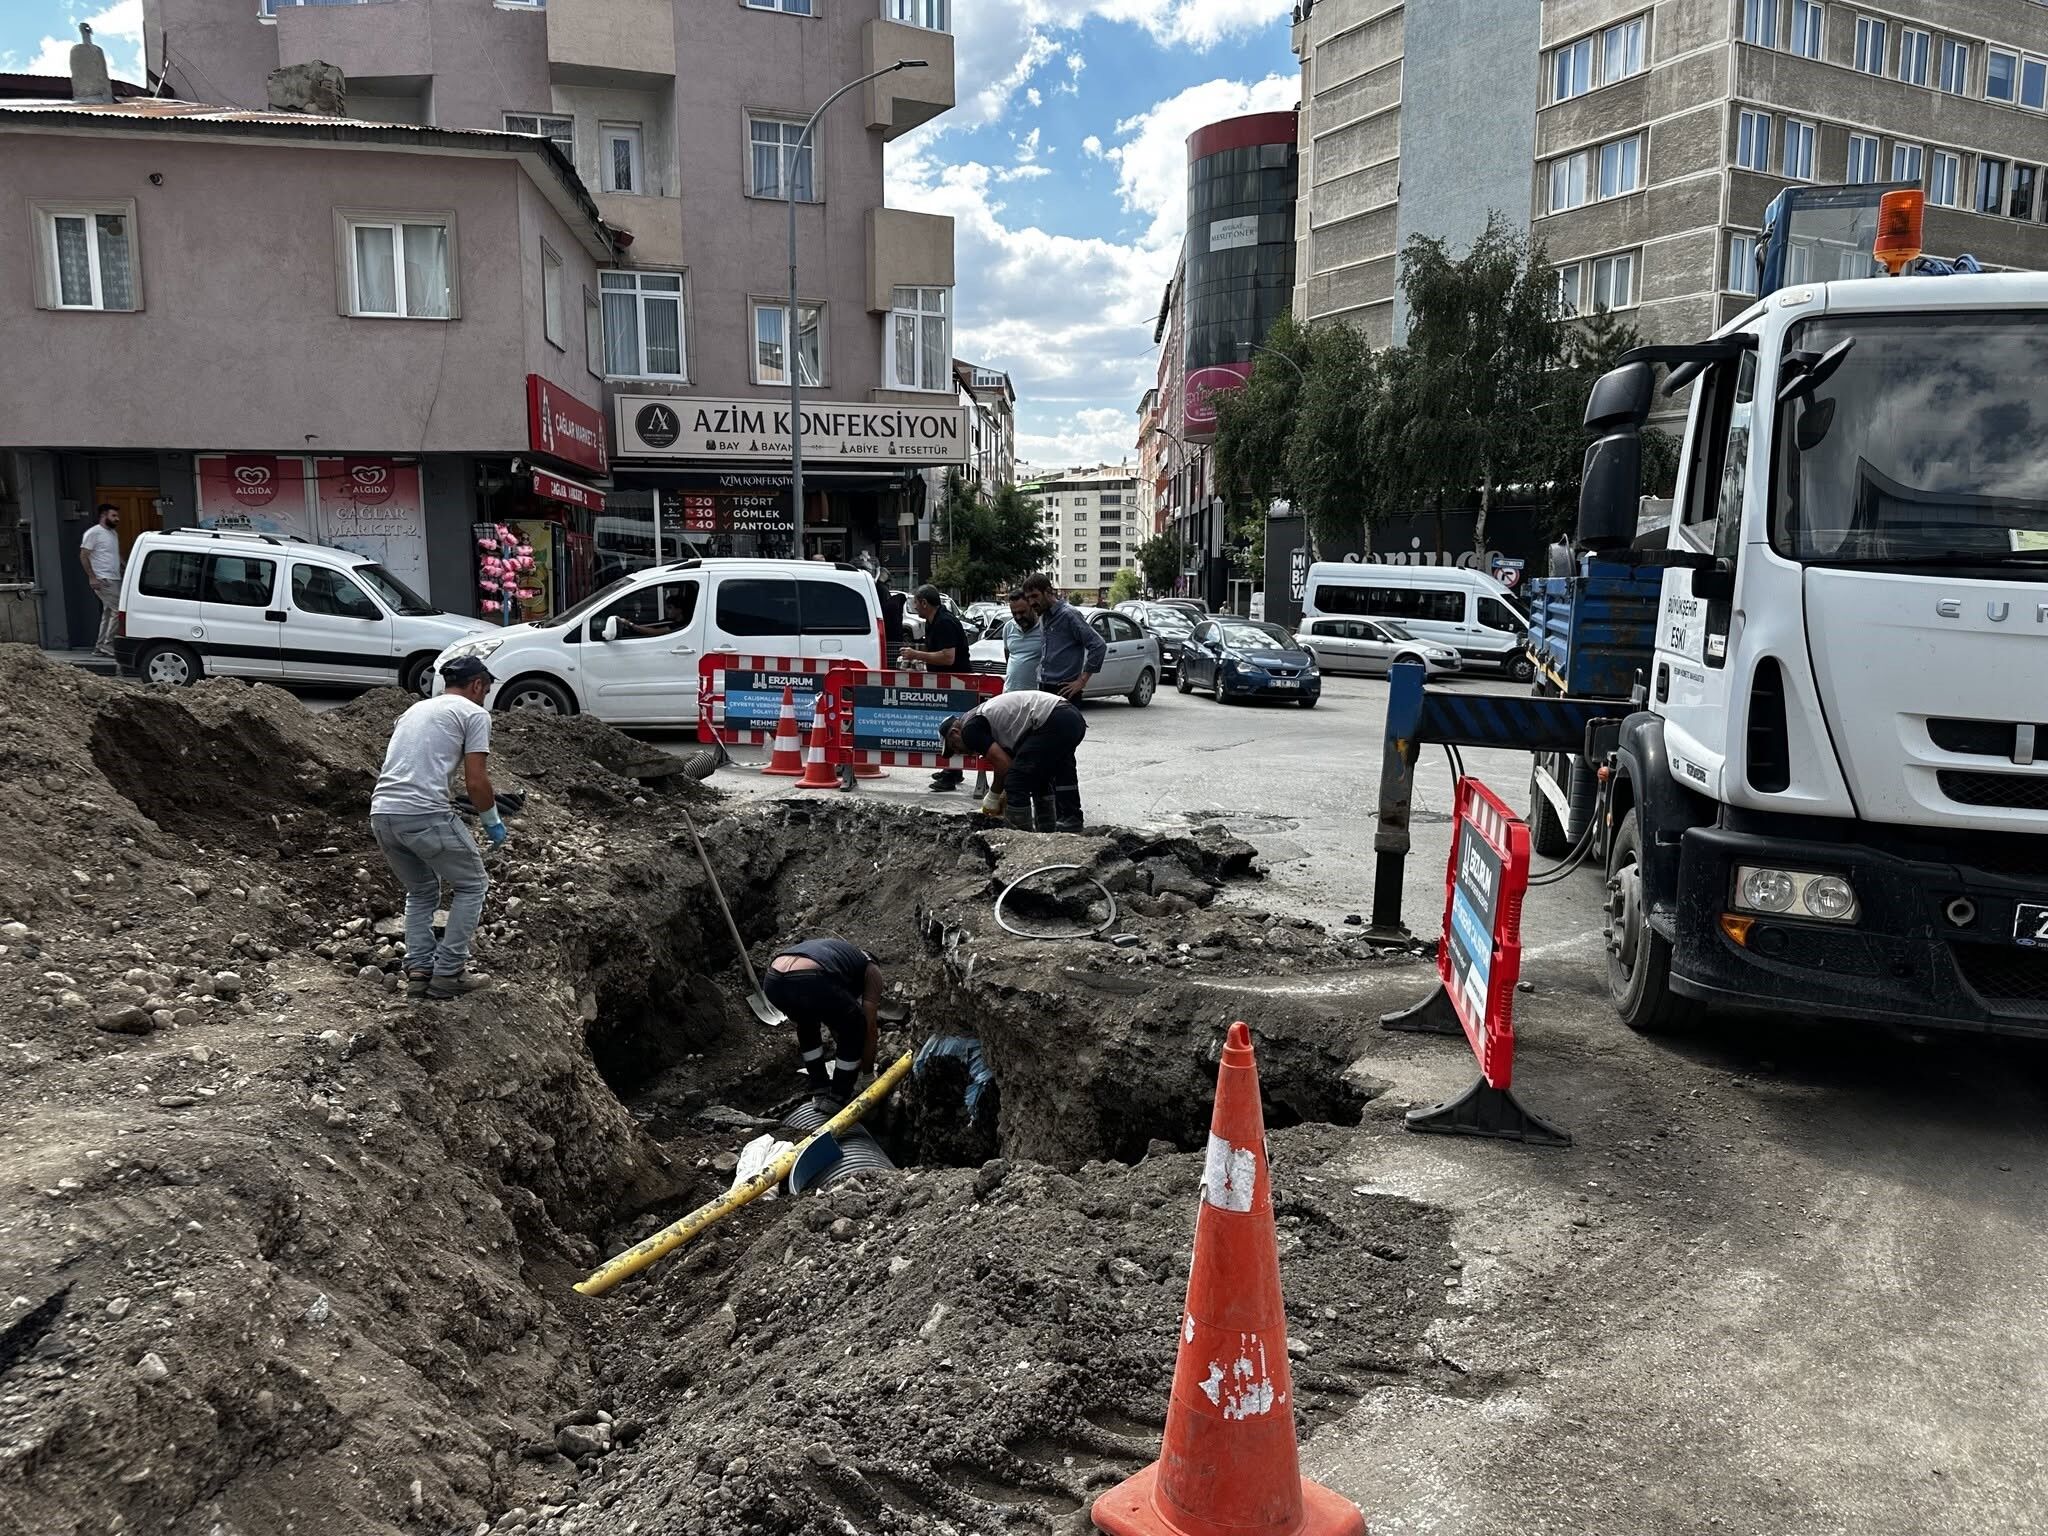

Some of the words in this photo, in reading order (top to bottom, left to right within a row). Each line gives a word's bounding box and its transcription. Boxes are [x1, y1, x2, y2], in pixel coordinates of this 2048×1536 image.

[693, 405, 766, 434] AZİM
[773, 410, 957, 439] KONFEKSİYON
[719, 442, 740, 451] BAY
[850, 443, 879, 454] ABİYE
[899, 444, 948, 455] TESETTÜR
[733, 497, 773, 506] TİŞÖRT
[733, 508, 780, 518] GÖMLEK
[733, 522, 794, 530] PANTOLON
[1671, 624, 1687, 650] ESKİ
[768, 676, 813, 686] ERZURUM
[900, 692, 948, 702] ERZURUM
[881, 738, 914, 747] MEHMET
